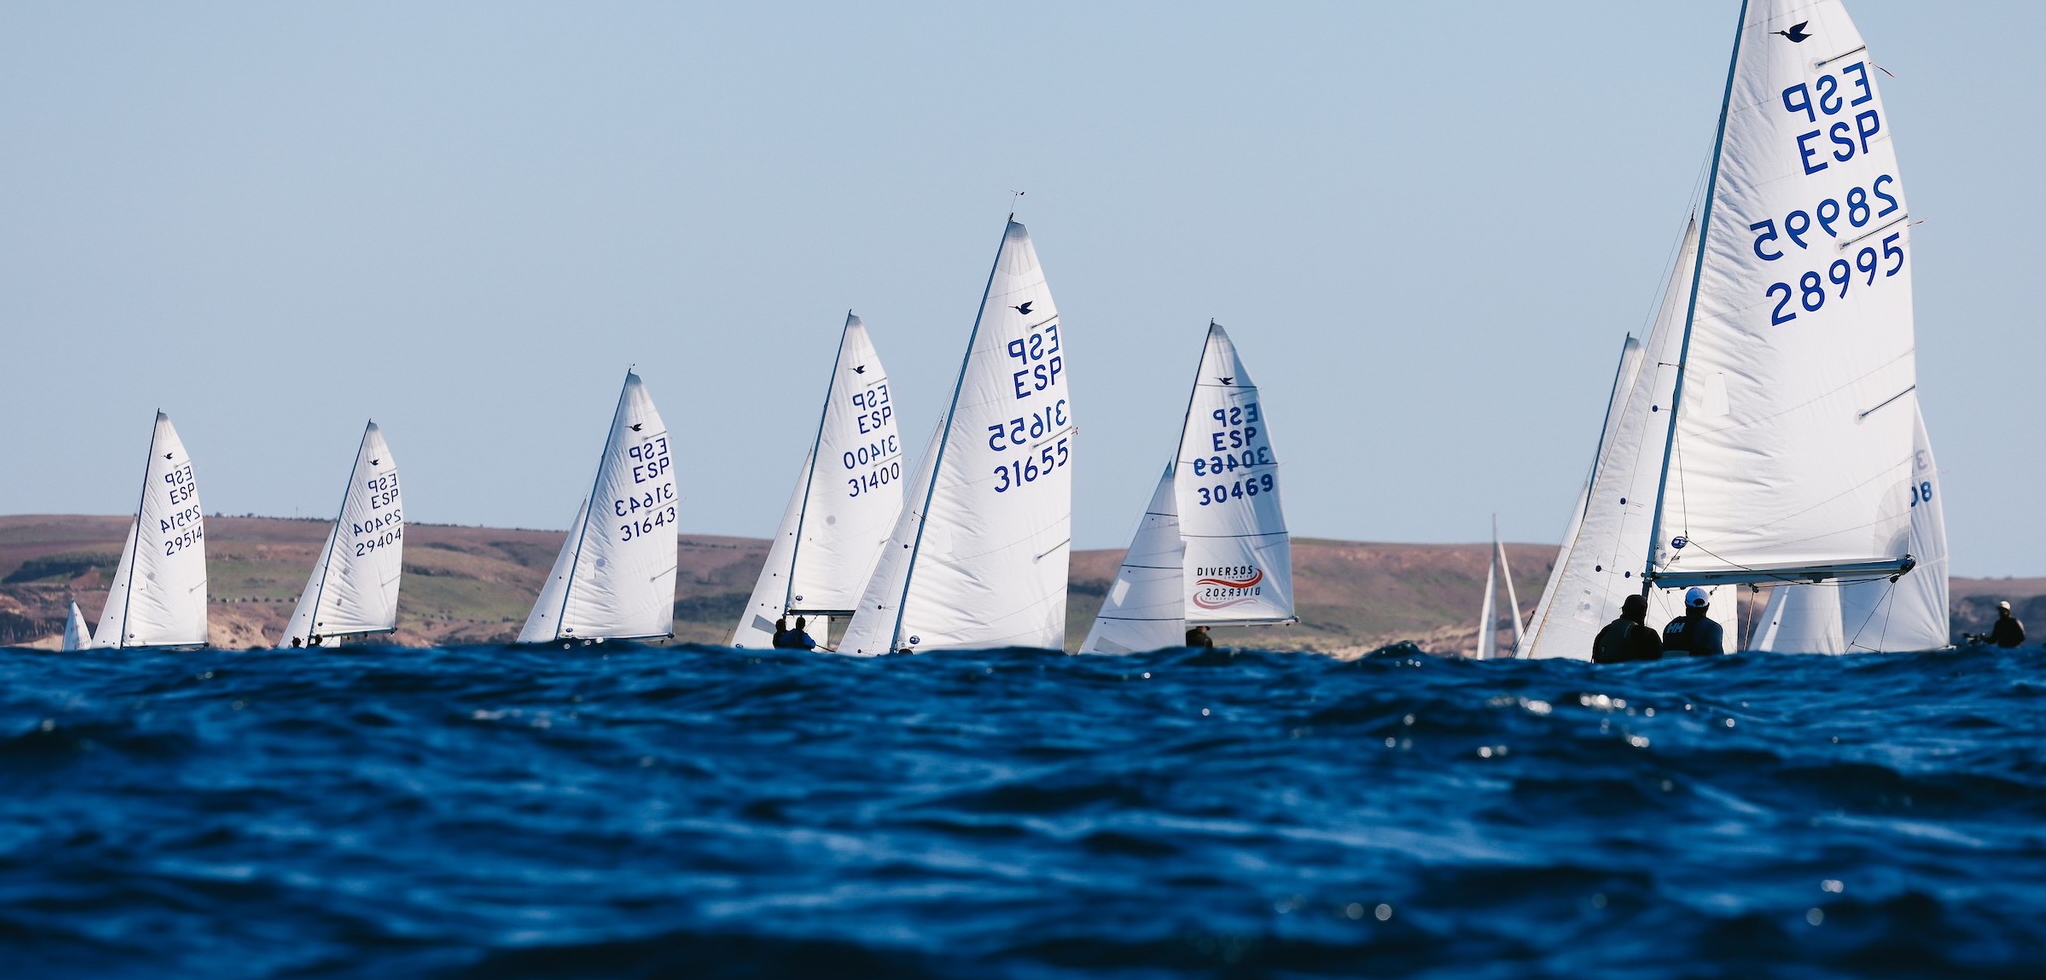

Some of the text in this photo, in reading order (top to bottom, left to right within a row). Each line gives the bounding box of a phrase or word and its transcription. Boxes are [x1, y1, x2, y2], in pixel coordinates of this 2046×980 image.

[1797, 110, 1880, 176] ESP
[1765, 232, 1905, 327] 28995
[1013, 356, 1062, 400] ESP
[857, 405, 892, 435] ESP
[1213, 426, 1257, 452] ESP
[632, 456, 670, 484] ESP
[848, 462, 900, 498] 31400
[993, 438, 1069, 494] 31655
[169, 482, 195, 506] ESP
[370, 488, 399, 510] ESP
[1197, 473, 1274, 507] 30469
[620, 506, 676, 541] 31643
[164, 524, 204, 557] 29514
[355, 527, 403, 557] 29404
[1197, 565, 1253, 577] DIVERSOS
